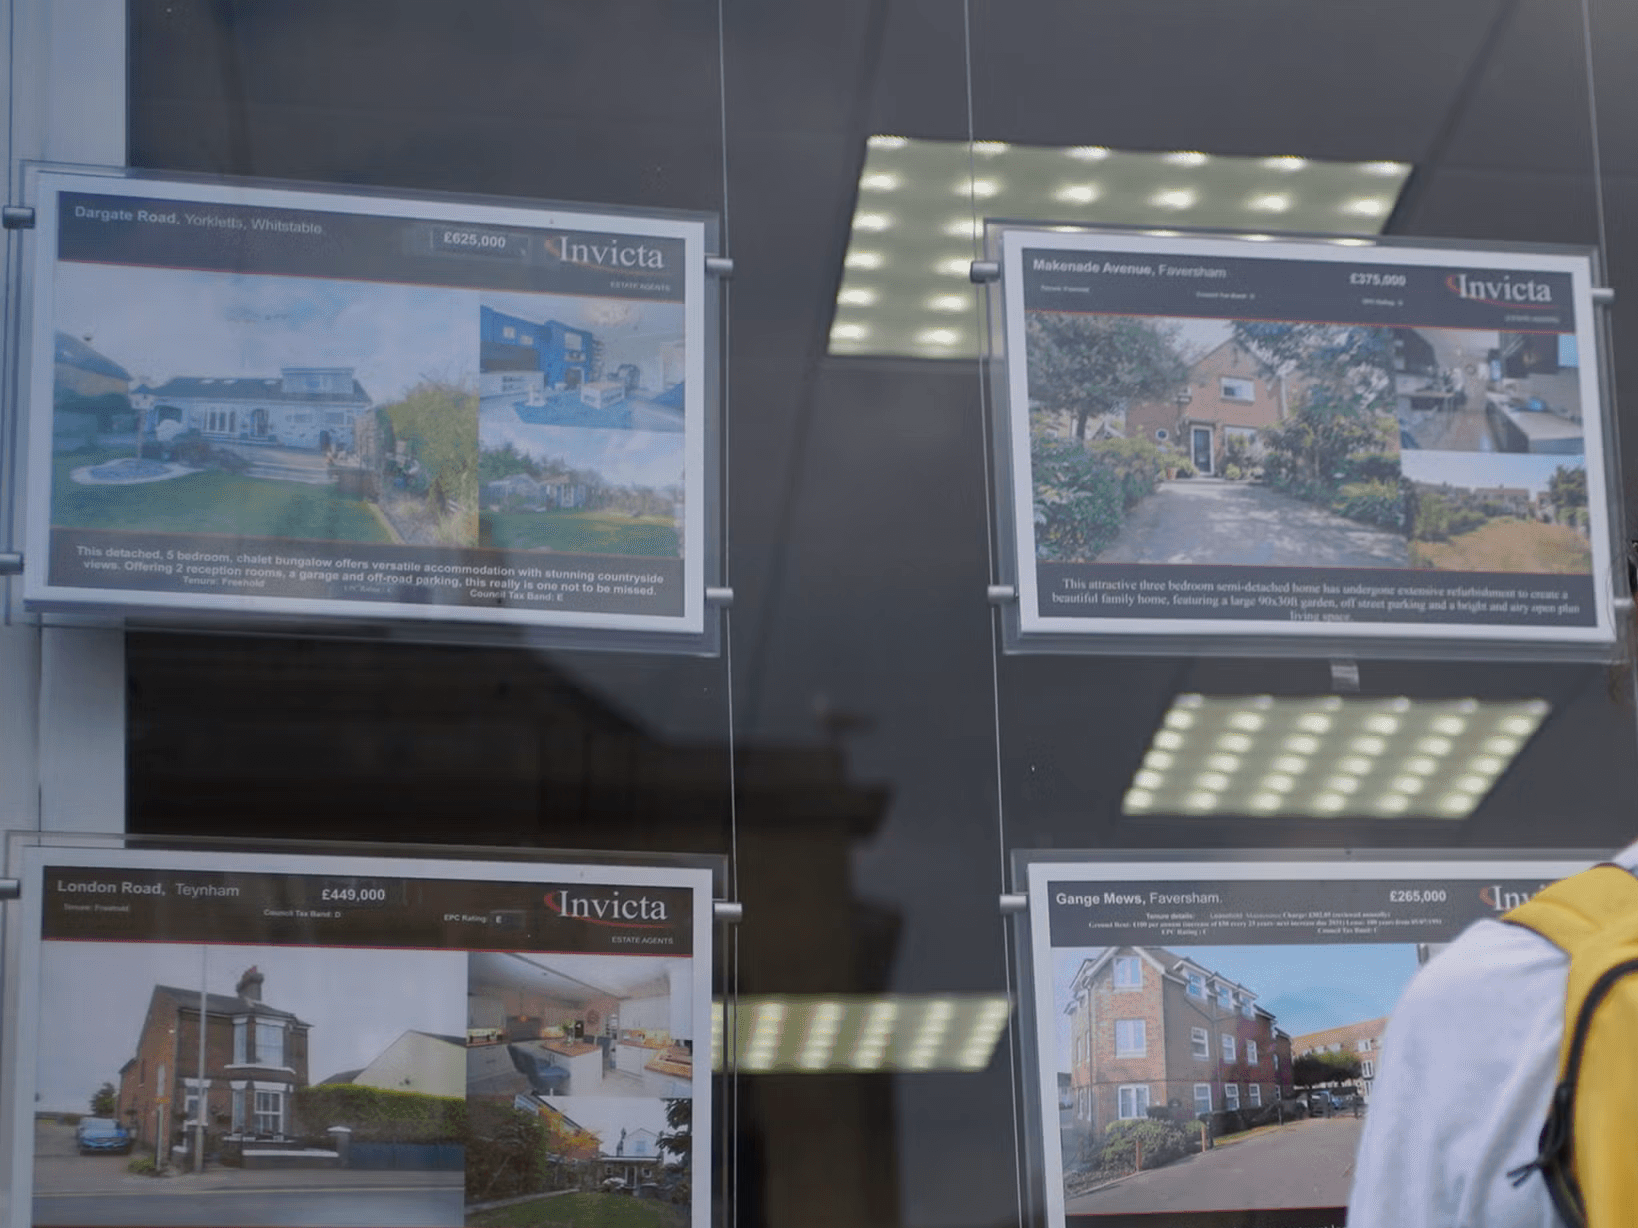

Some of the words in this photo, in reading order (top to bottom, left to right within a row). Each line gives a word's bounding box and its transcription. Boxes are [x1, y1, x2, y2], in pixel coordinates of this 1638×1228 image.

[443, 231, 506, 249] £625,000
[560, 236, 665, 269] Invicta
[1458, 273, 1553, 302] Invicta
[57, 879, 116, 893] London
[121, 881, 165, 896] Road,
[175, 882, 240, 898] Teynham
[321, 886, 386, 903] £449,000
[1389, 890, 1447, 905] £265,000
[558, 890, 668, 920] Invicta
[1055, 892, 1100, 907] Gange
[1103, 892, 1146, 905] Mews,
